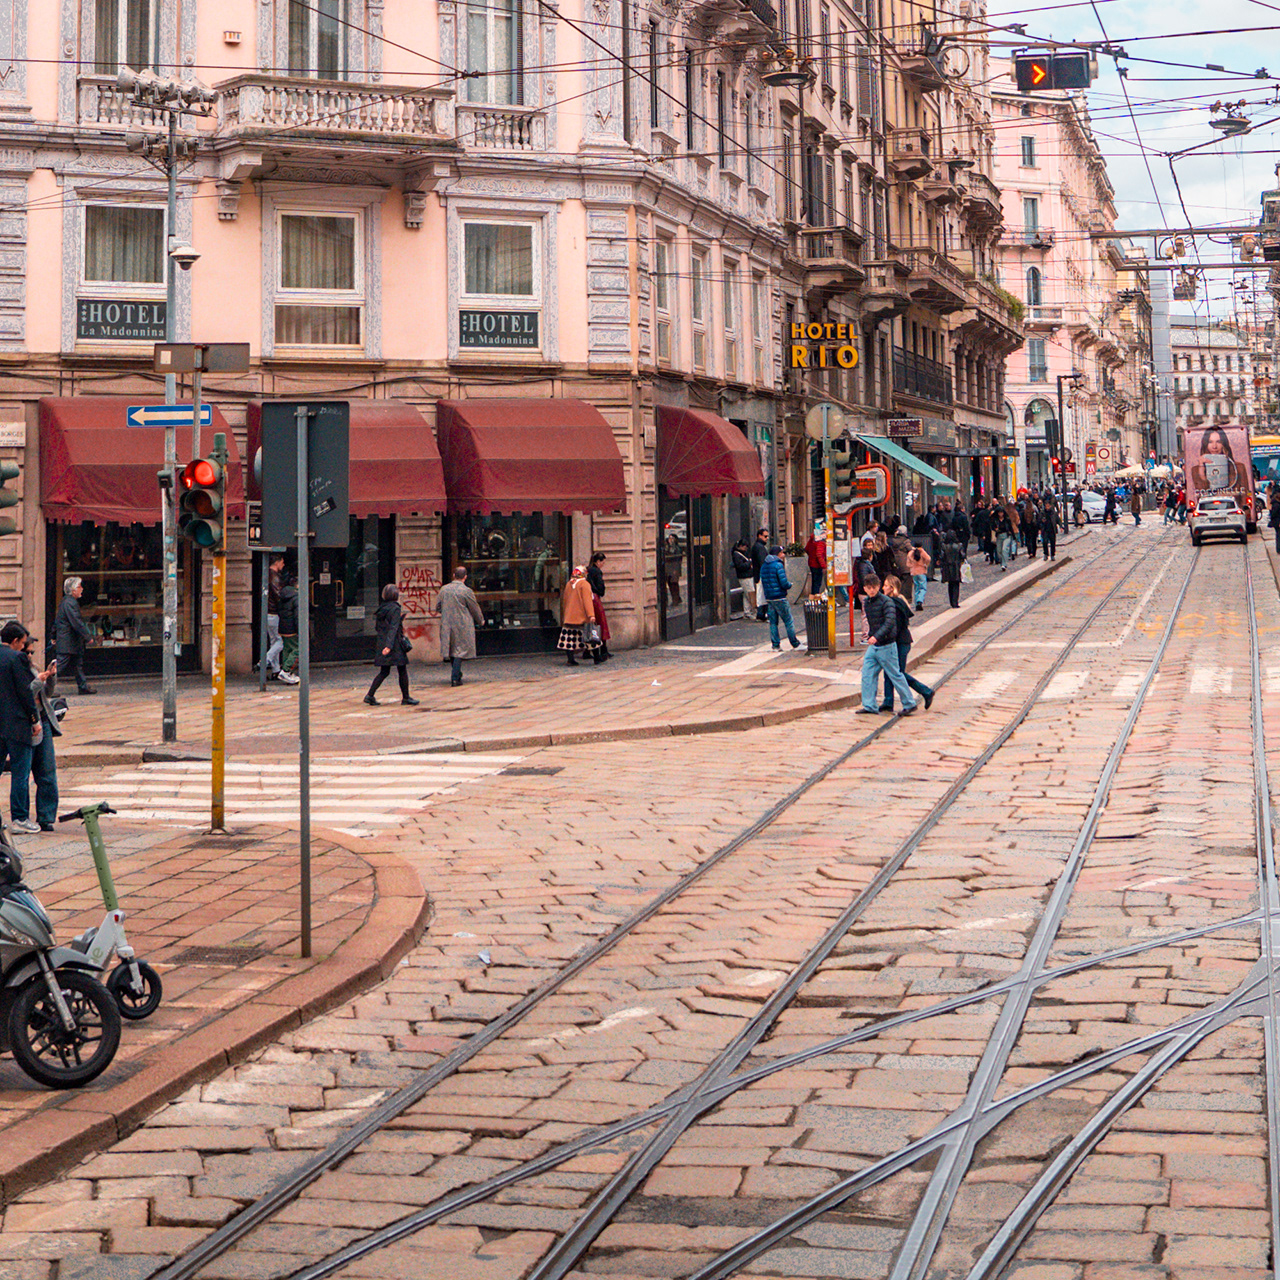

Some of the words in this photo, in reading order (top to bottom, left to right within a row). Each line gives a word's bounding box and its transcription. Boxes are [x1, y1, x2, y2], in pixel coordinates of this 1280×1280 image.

[89, 303, 165, 324] HOTEL
[81, 325, 95, 336] La
[101, 326, 164, 337] Madonnina
[469, 314, 533, 333] HOTEL
[791, 322, 858, 339] HOTEL
[462, 334, 475, 344] La
[479, 334, 534, 345] Madonnina
[792, 345, 859, 368] RIO
